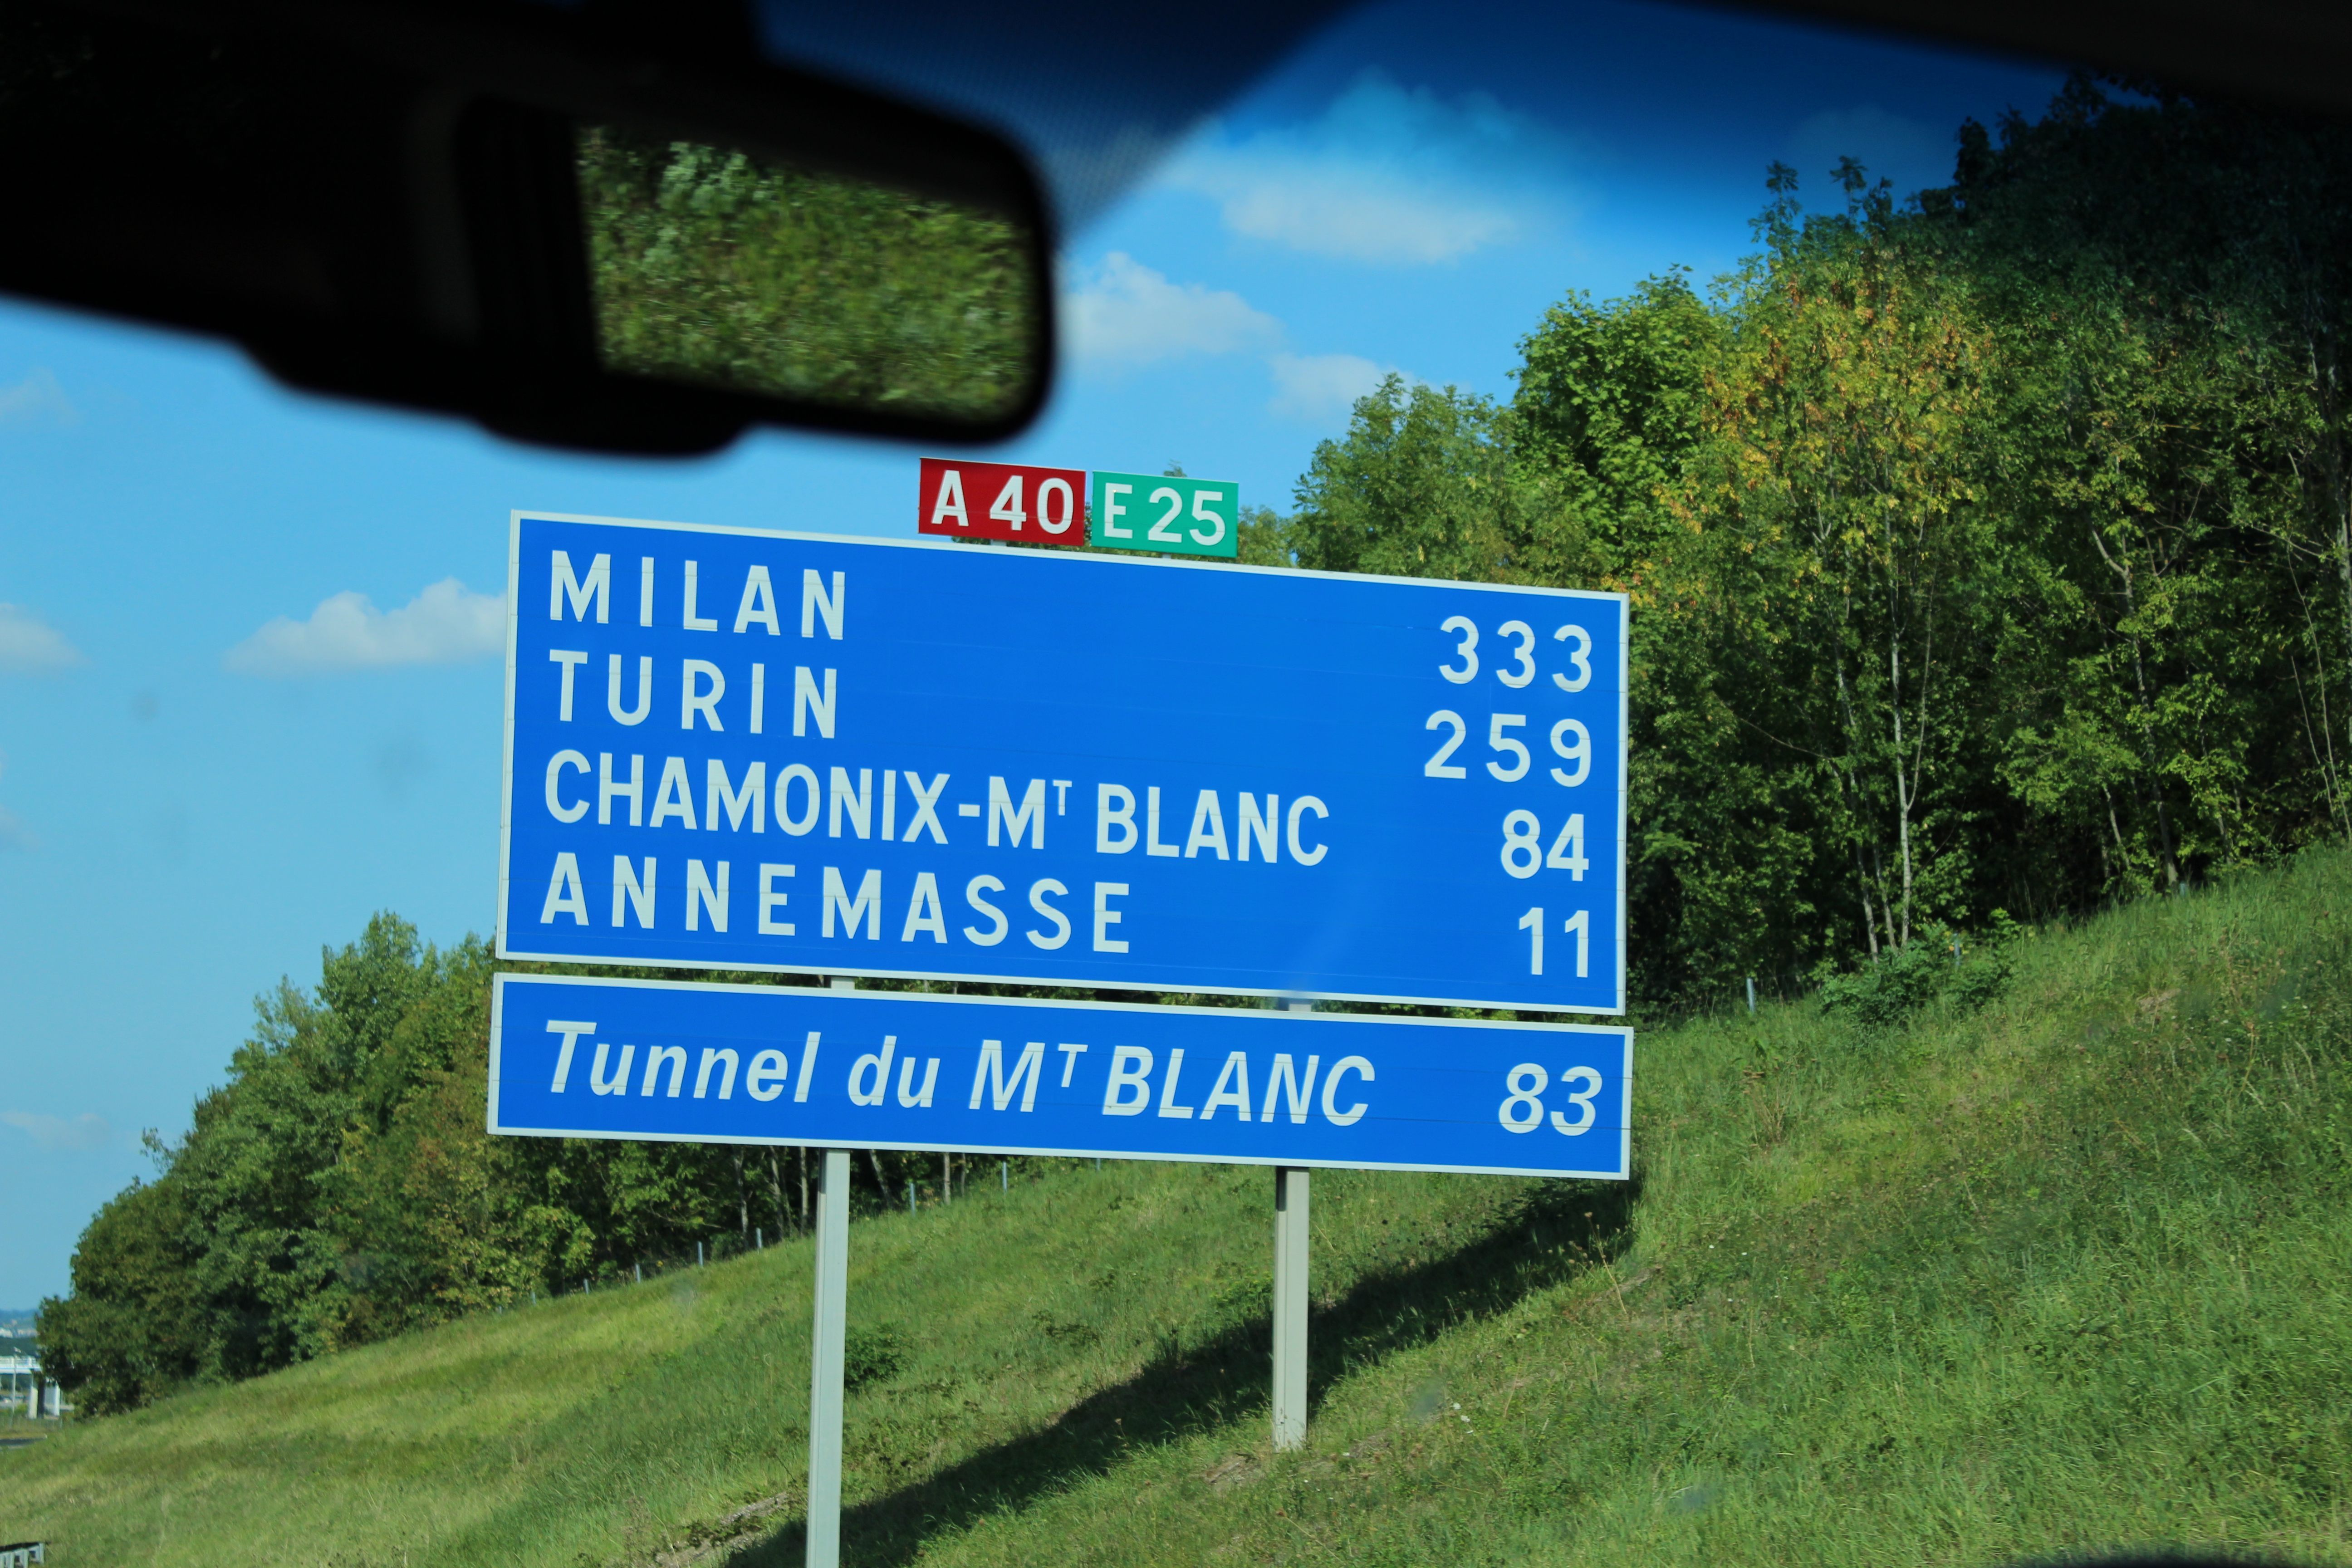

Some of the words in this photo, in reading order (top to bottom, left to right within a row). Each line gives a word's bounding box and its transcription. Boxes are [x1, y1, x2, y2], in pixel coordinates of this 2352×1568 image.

[931, 470, 969, 526] A
[990, 475, 1074, 534] 40
[1105, 483, 1132, 539] E
[1148, 487, 1225, 546] 25
[550, 550, 845, 640] MILAN
[1439, 616, 1592, 693] 333
[549, 649, 837, 739] TURIN
[1425, 710, 1591, 787] 259
[545, 750, 1073, 849] CHAMONIX-MT
[1097, 784, 1329, 866] BLANC
[1501, 809, 1589, 882] 84
[540, 853, 1129, 954] ANNEMASSE
[1519, 907, 1589, 978] 11
[546, 1020, 821, 1102] Tunnel
[848, 1035, 941, 1109] du
[969, 1040, 1088, 1112] MT
[1102, 1046, 1375, 1127] BLANC
[1499, 1063, 1602, 1136] 83
